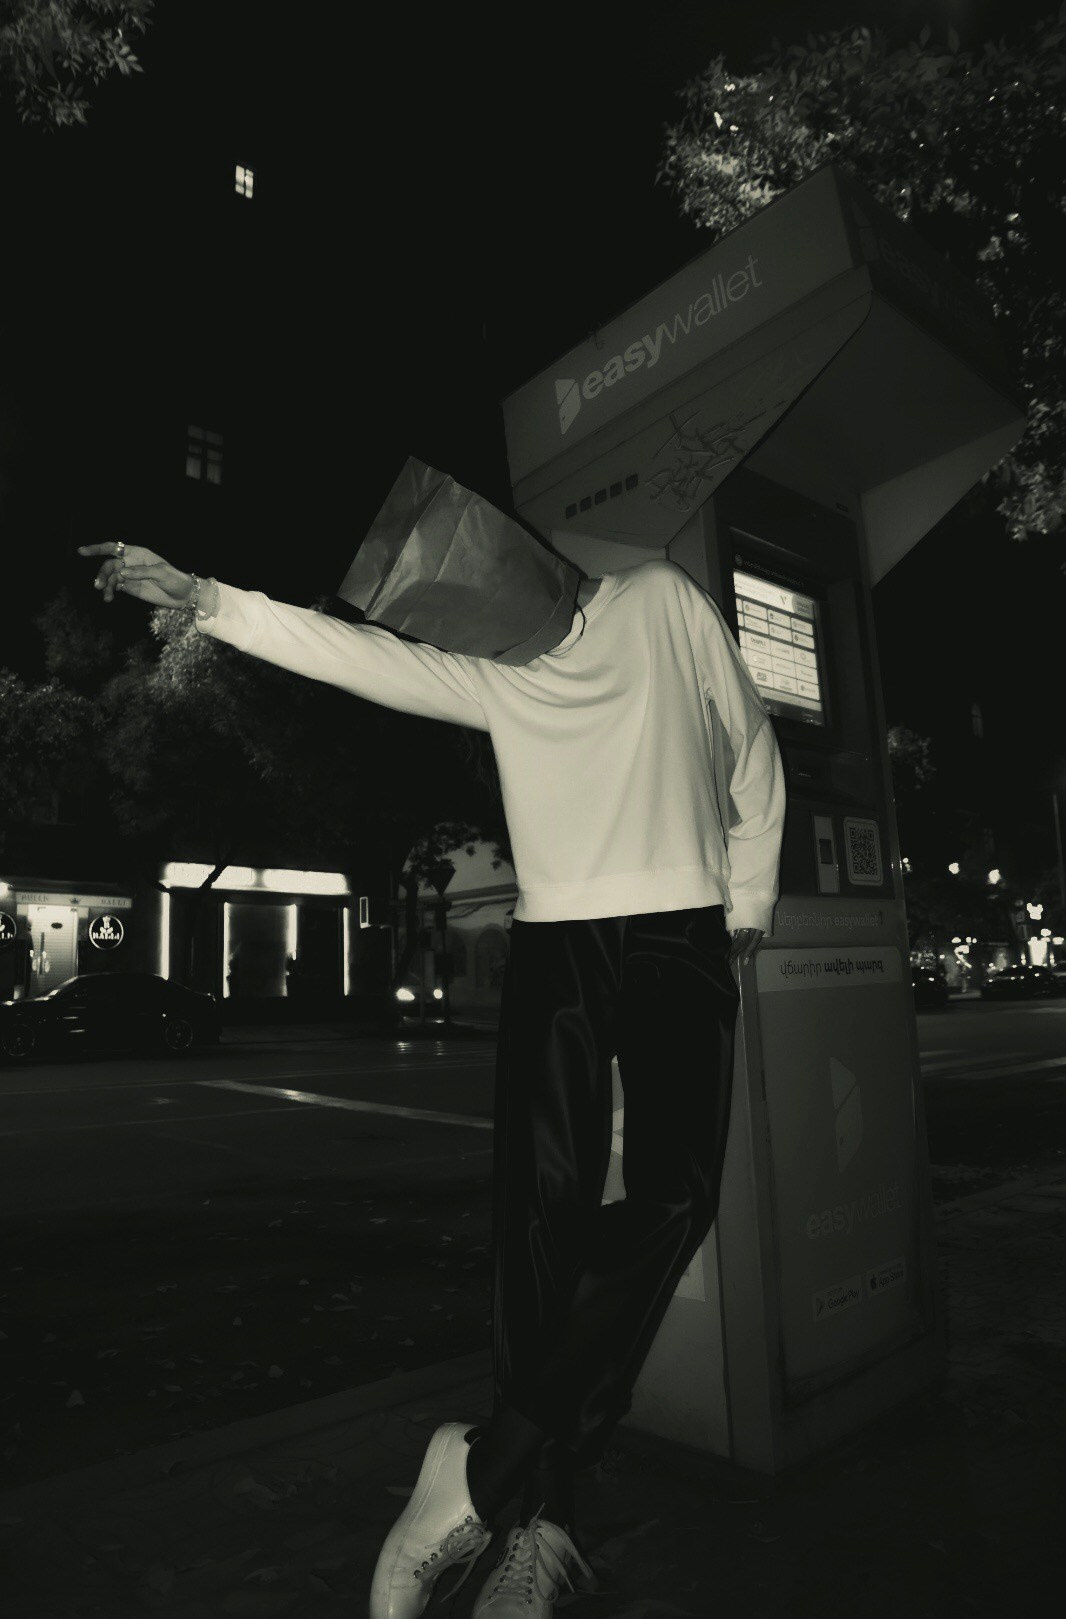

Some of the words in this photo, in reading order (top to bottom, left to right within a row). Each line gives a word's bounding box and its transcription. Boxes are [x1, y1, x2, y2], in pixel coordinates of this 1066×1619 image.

[582, 254, 762, 399] easywallet
[835, 913, 879, 930] easywallet
[824, 958, 854, 976] ավելի
[856, 960, 884, 974] պարզ
